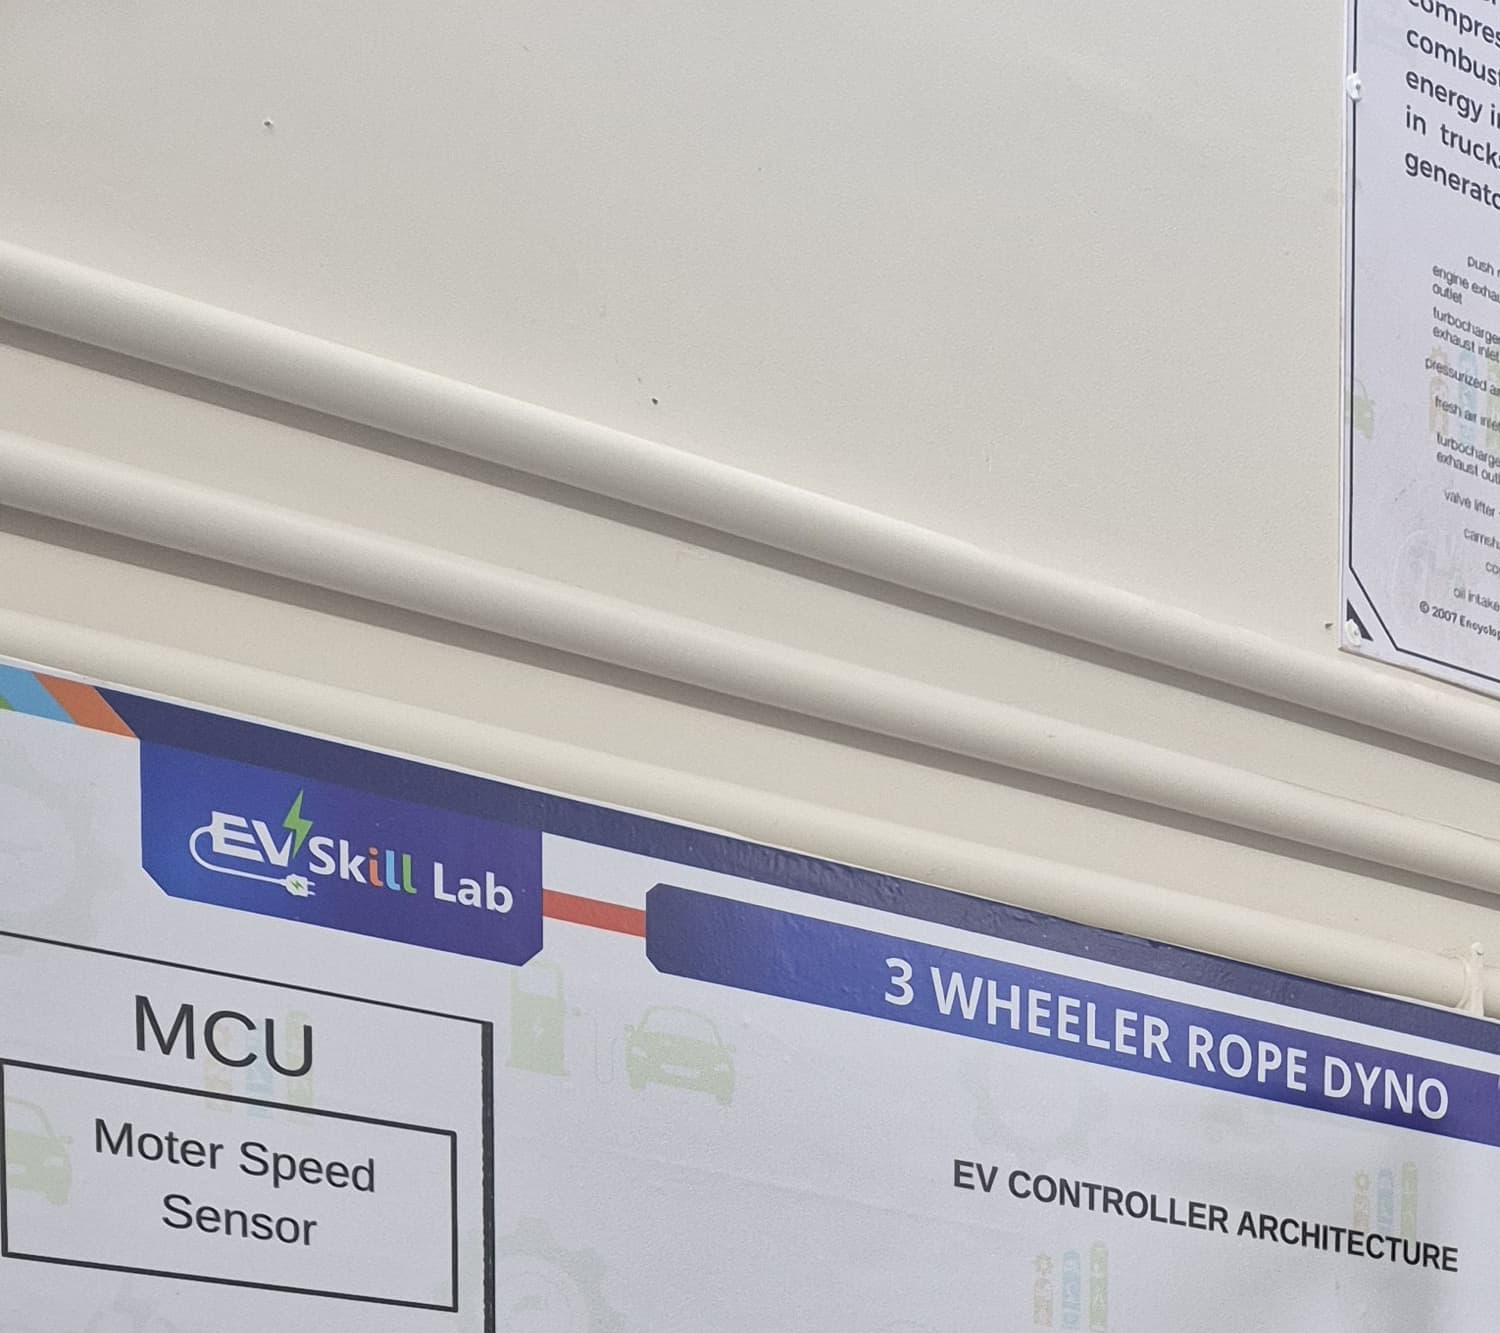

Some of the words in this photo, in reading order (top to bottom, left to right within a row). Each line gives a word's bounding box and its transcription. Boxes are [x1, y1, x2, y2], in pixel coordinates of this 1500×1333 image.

[1433, 265, 1469, 290] engine
[1468, 256, 1494, 276] push
[308, 836, 417, 894] Skill
[434, 861, 514, 914] Lab
[136, 995, 312, 1078] MCU
[885, 957, 913, 1006] 3
[931, 967, 1171, 1063] WHEELER
[1189, 1025, 1307, 1092] ROPE
[1324, 1055, 1448, 1120] DYNO
[96, 1118, 224, 1169] Moter
[240, 1141, 374, 1193] Speed
[163, 1193, 317, 1246] Sensor
[954, 1159, 998, 1193] EV
[1009, 1170, 1228, 1234] CONTROLLER
[1237, 1211, 1458, 1273] ARCHITECTURE
